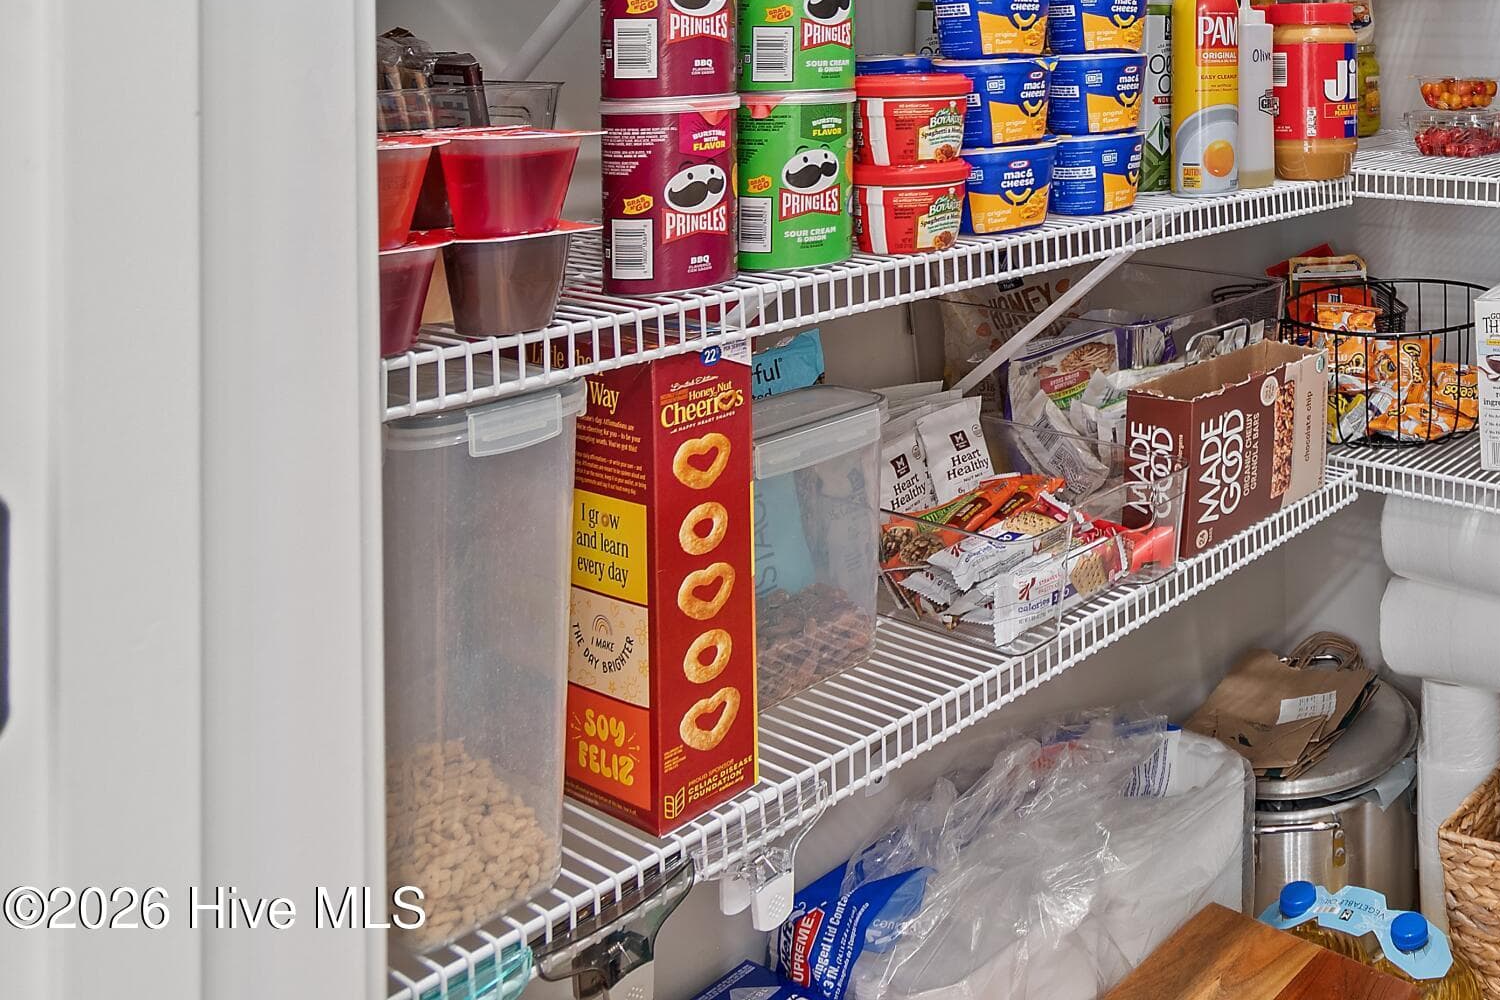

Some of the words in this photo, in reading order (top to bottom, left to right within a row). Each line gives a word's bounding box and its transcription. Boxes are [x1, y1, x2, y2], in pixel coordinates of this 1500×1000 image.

[670, 12, 728, 40] PRINGLES
[804, 22, 851, 47] PRINGLES
[1197, 16, 1238, 46] PAM
[694, 58, 713, 67] BBQ
[806, 60, 829, 68] SOUR
[1202, 52, 1237, 60] ORIGINAL
[1324, 58, 1357, 102] Ji
[692, 130, 726, 140] BURSTING
[693, 142, 726, 151] FLAVOR
[812, 128, 842, 137] FLAVOR
[782, 188, 840, 218] PRINGLES
[665, 206, 726, 240] PRINGLES
[784, 228, 808, 238] SOUR
[809, 226, 836, 236] CREAM
[803, 234, 827, 242] ONION
[690, 255, 710, 264] BBQ
[704, 348, 717, 363] 22
[590, 380, 620, 416] Way
[688, 385, 715, 402] Honey
[717, 380, 732, 392] Nut
[660, 388, 744, 429] Cheerios
[679, 422, 696, 433] HAPPY
[698, 417, 714, 427] HEART
[716, 411, 736, 422] SHAPES
[1245, 413, 1253, 449] CHEWY
[1252, 412, 1260, 442] BARS
[1304, 416, 1313, 462] chocolate
[946, 458, 990, 482] Healthy
[950, 449, 982, 467] Heart
[1129, 421, 1152, 515] MADE
[1150, 426, 1173, 519] GOOD
[1198, 415, 1225, 524] MADE
[1220, 408, 1244, 515] GOOD
[1250, 444, 1259, 490] GRANOLA
[893, 473, 920, 495] Heart
[1243, 452, 1252, 497] ORGANIC
[890, 484, 927, 510] Healthy
[576, 529, 598, 550] and
[600, 533, 629, 559] learn
[577, 558, 605, 582] every
[608, 565, 629, 588] day
[573, 622, 584, 647] THE
[583, 649, 600, 670] DAY
[602, 636, 635, 675] BRIGHTER
[595, 638, 615, 653] MAKE
[584, 708, 626, 748] SOY
[578, 748, 635, 787] FELIZ
[688, 775, 718, 796] CELIAC
[720, 755, 753, 777] DISEASE
[688, 768, 742, 804] FOUNDATION
[1340, 898, 1386, 918] VEGETABLE
[792, 914, 815, 982] UPREME
[823, 926, 838, 942] Lid
